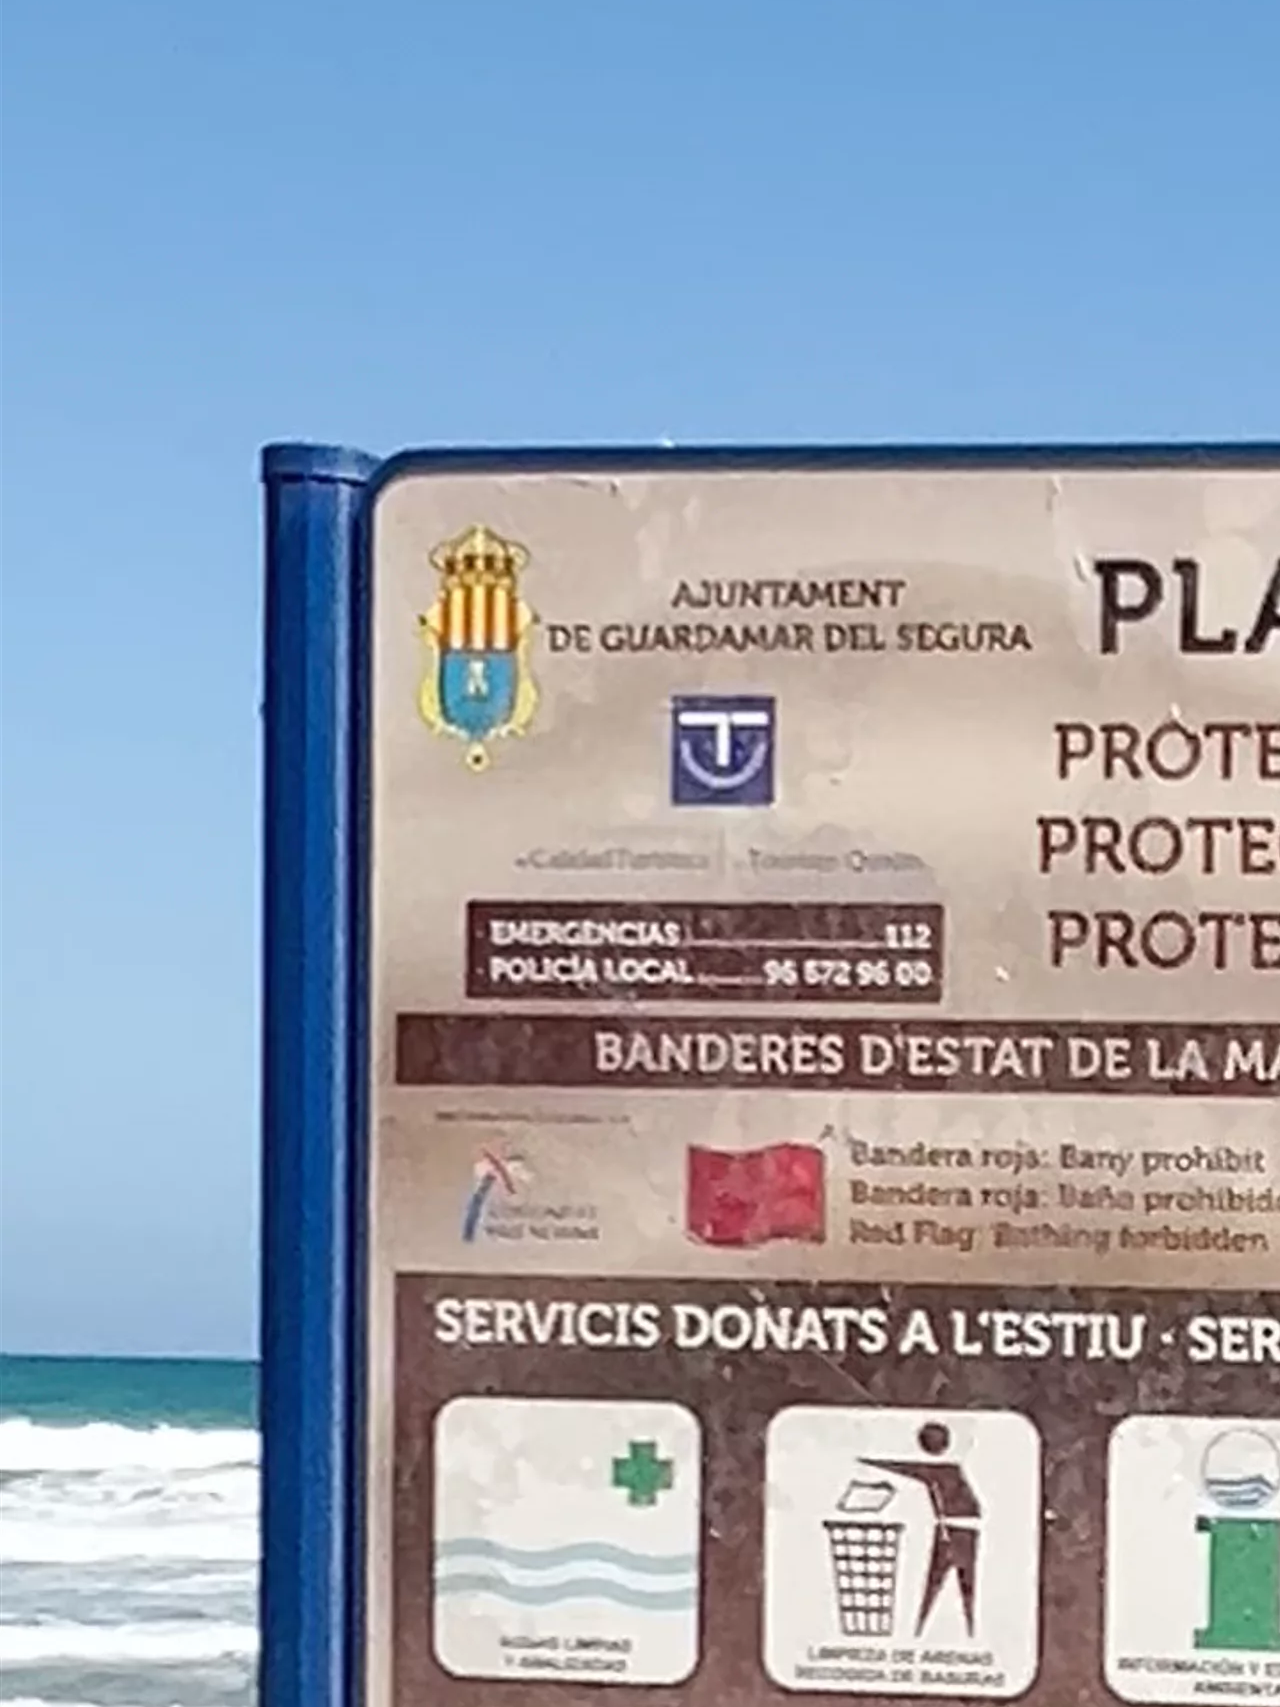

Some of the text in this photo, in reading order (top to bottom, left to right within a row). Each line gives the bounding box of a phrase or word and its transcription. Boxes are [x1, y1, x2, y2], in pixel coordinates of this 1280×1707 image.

[671, 580, 906, 608] AJUNTAMENT
[548, 624, 1033, 653] DE GUARDAMAR DEL SEGURA
[490, 921, 932, 949] EMERGENCIAS 112
[604, 959, 692, 984] LOCAL
[596, 1033, 843, 1073] BANDERES
[861, 1035, 1054, 1077] D'ESTAT
[1068, 1039, 1131, 1078] DE
[1148, 1040, 1207, 1079] LA
[849, 1142, 972, 1167] Bandera
[1142, 1146, 1265, 1175] prohibit
[849, 1180, 972, 1206] Bandera
[435, 1299, 660, 1348] SERVICIS
[672, 1303, 888, 1353] DONATS
[901, 1314, 938, 1353] A
[955, 1312, 1144, 1357] L'ESTIU
